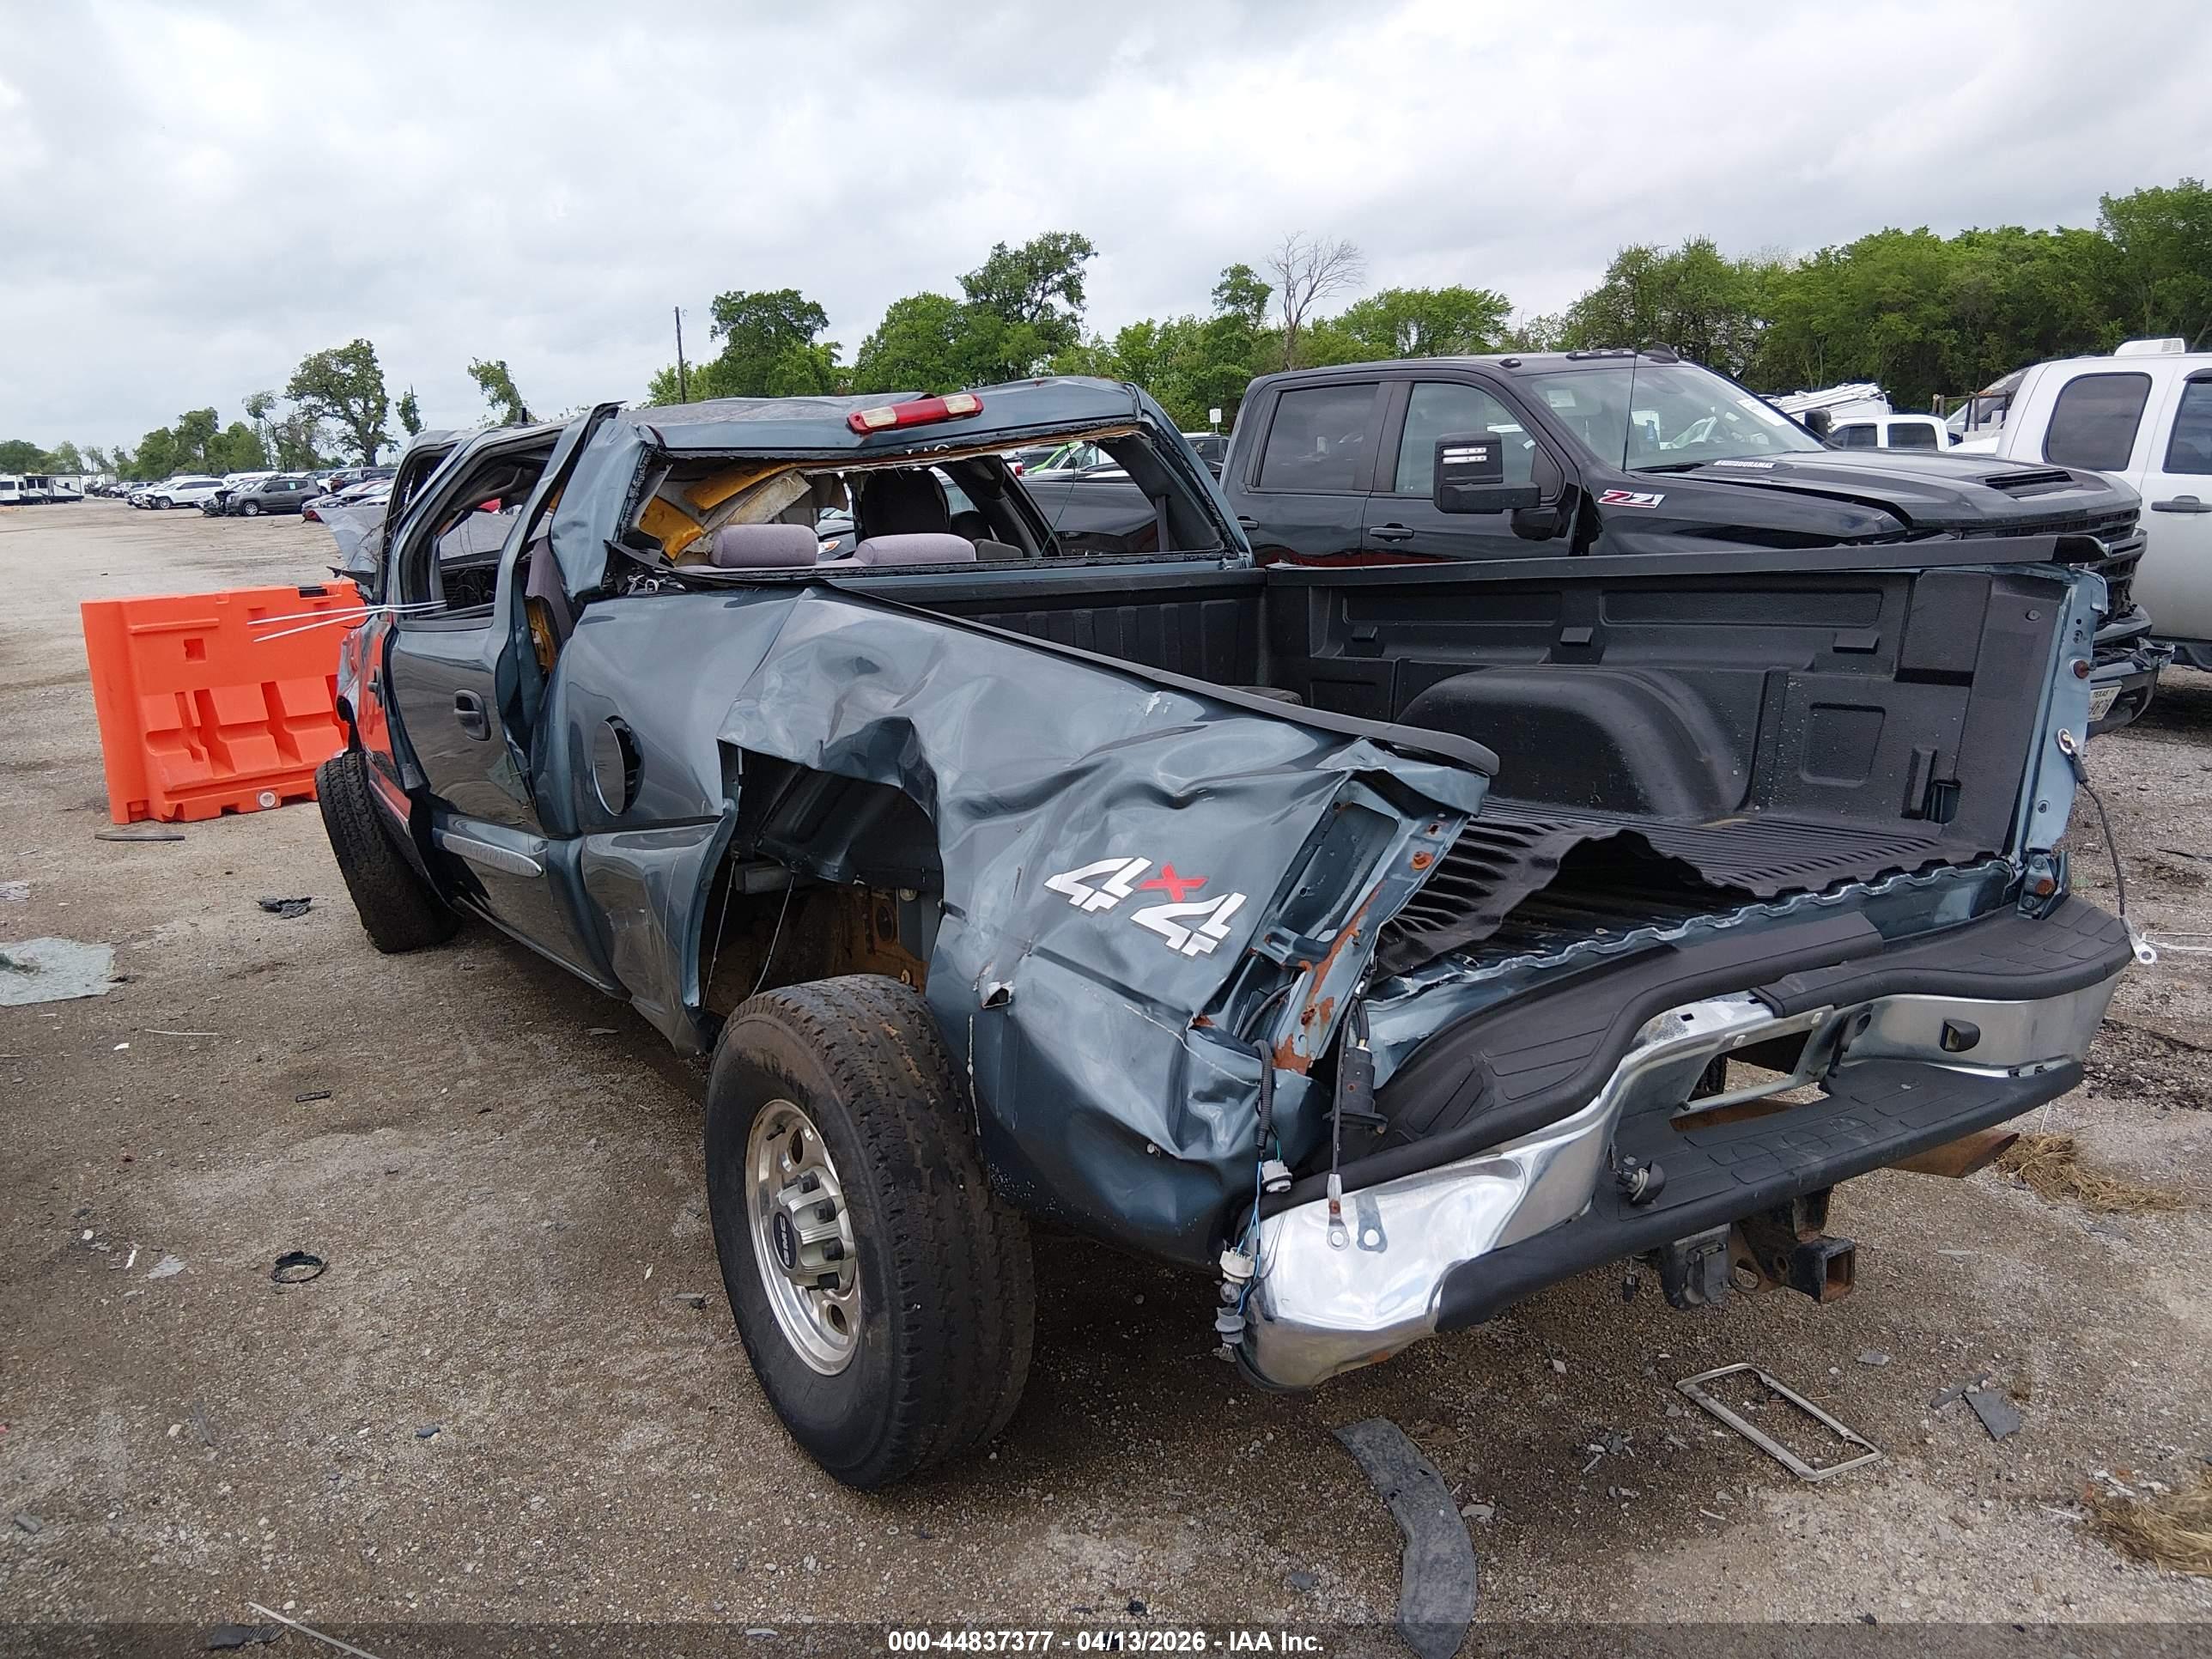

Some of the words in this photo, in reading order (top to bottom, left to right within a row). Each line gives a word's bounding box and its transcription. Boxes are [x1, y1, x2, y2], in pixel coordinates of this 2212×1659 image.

[1597, 489, 1666, 508] Z71
[2094, 690, 2110, 698] TEXAS
[779, 1215, 790, 1266] GMC
